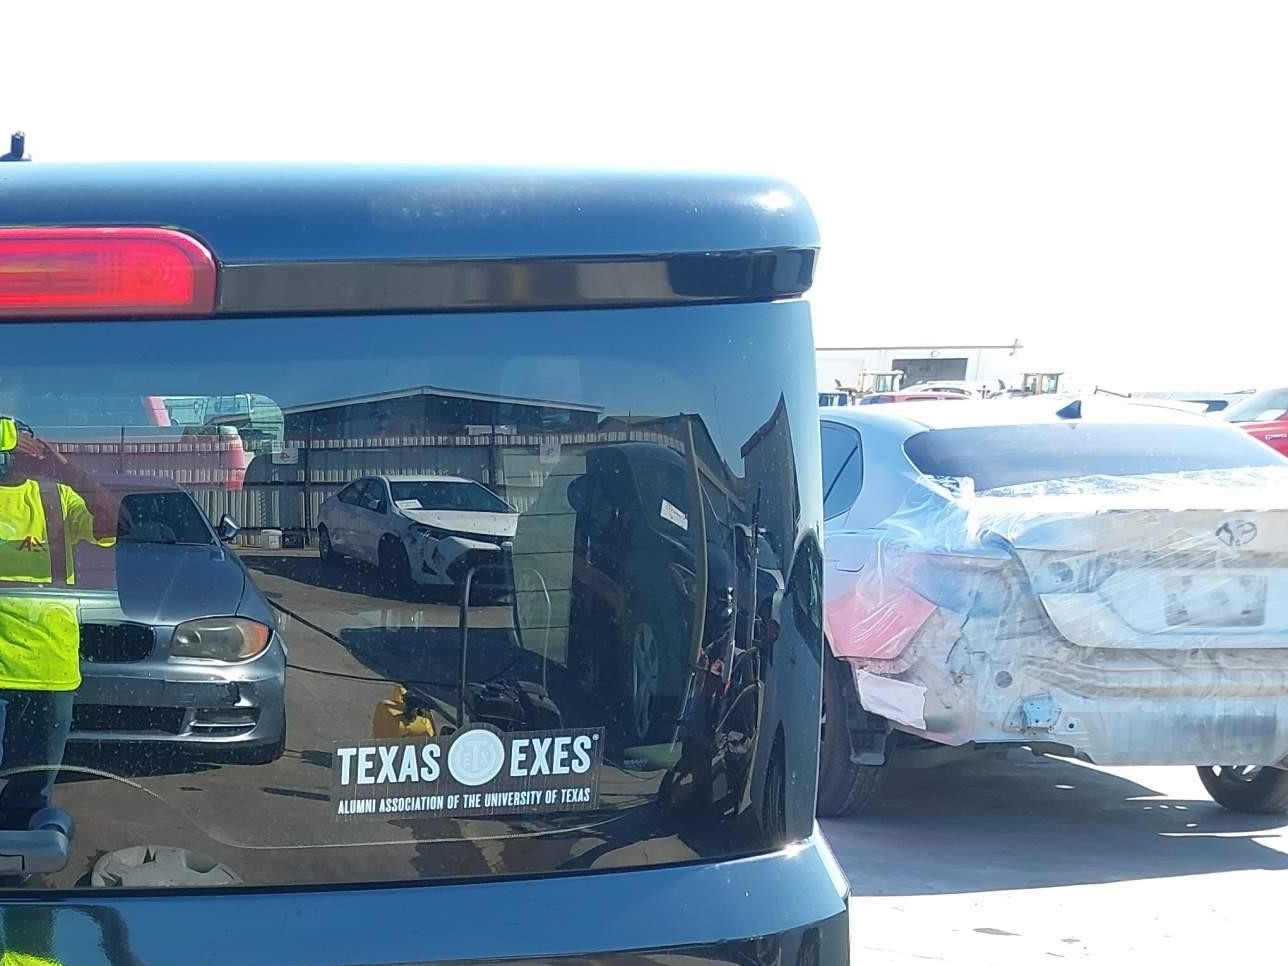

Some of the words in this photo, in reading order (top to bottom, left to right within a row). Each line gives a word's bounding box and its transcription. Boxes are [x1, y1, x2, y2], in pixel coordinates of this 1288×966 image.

[337, 744, 441, 785] TEXAS
[510, 735, 592, 777] EXES
[338, 799, 376, 815] ALUMNI
[379, 796, 444, 812] ASSOCIATION
[447, 794, 460, 809] OF
[463, 793, 481, 809] THE
[484, 789, 542, 807] UNIVERSITY
[545, 789, 558, 804] OF
[561, 787, 591, 803] TEXAS
